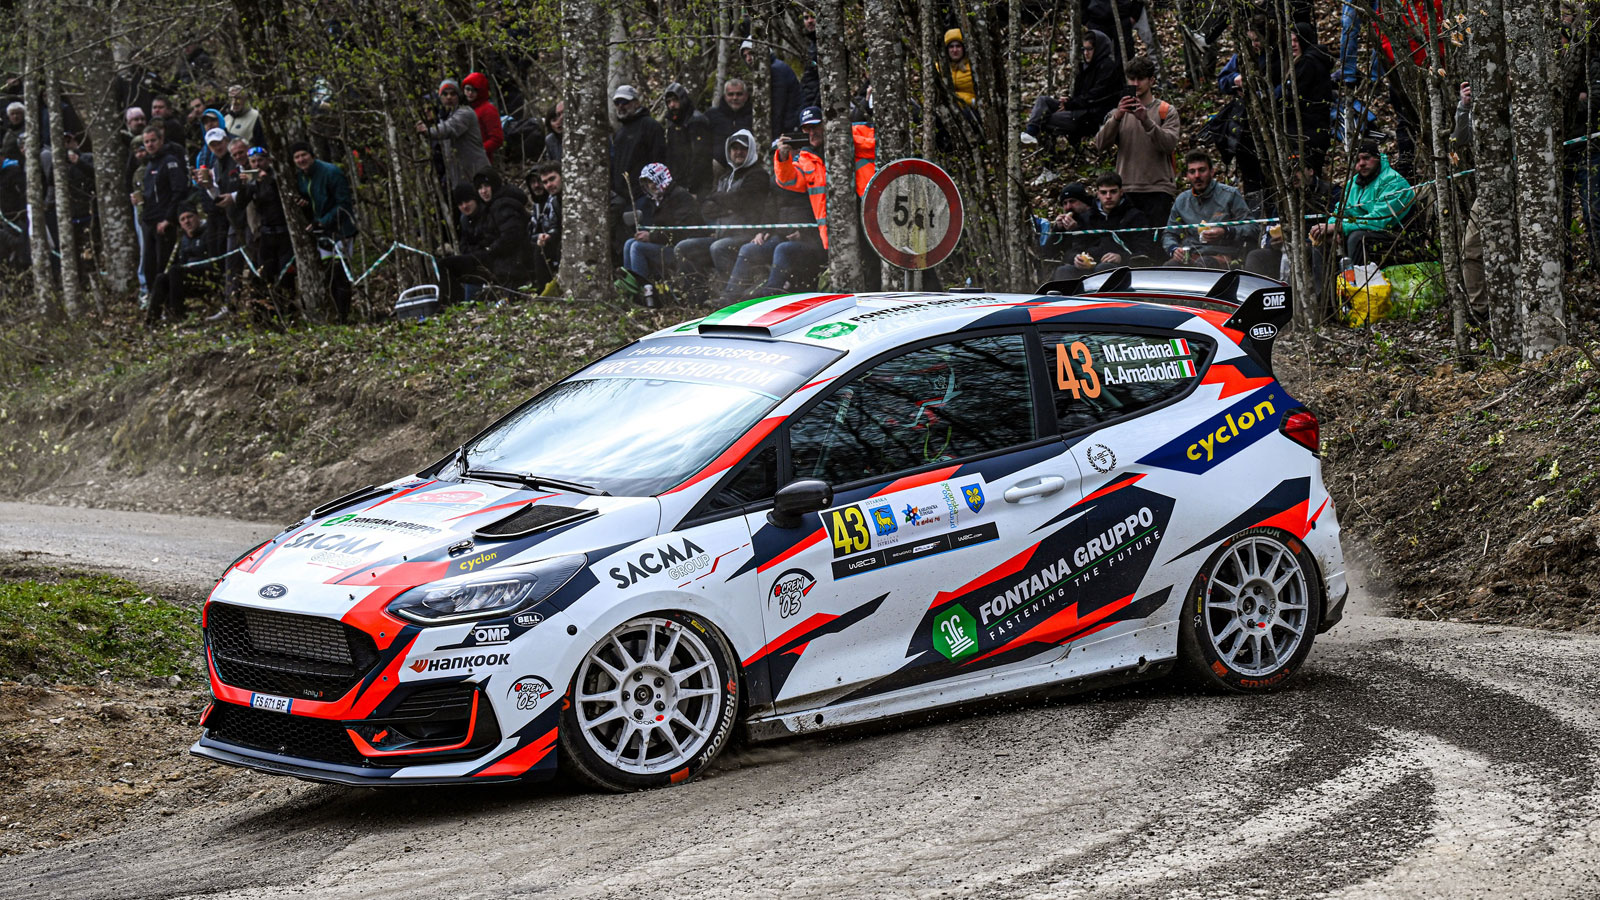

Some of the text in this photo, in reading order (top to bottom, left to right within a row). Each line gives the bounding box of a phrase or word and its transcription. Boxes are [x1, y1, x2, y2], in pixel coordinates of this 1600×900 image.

[1262, 293, 1286, 308] OMP
[849, 302, 928, 323] FONTANA
[1252, 326, 1274, 337] BELL
[672, 345, 793, 366] MOTORSPORT
[1102, 342, 1173, 363] M.Fontana
[586, 356, 781, 387] WRC-FANSHOP.COM
[1056, 341, 1101, 400] 43
[1103, 361, 1181, 386] A.Arnaboldi
[1186, 400, 1276, 462] cyclon
[832, 506, 870, 554] 43
[283, 532, 384, 555] SACMA
[459, 551, 497, 571] cyclon
[609, 537, 705, 589] SACMA
[668, 553, 711, 581] GROUP
[978, 506, 1153, 625] FONTANA GRUPPO
[261, 585, 283, 598] Ford
[774, 576, 805, 598] #CREW
[989, 530, 1161, 641] FASTENING THE FUTURE
[517, 615, 540, 623] BELL
[475, 627, 510, 642] OMP
[514, 682, 544, 693] #CREW
[255, 696, 287, 710] FS 671 BF
